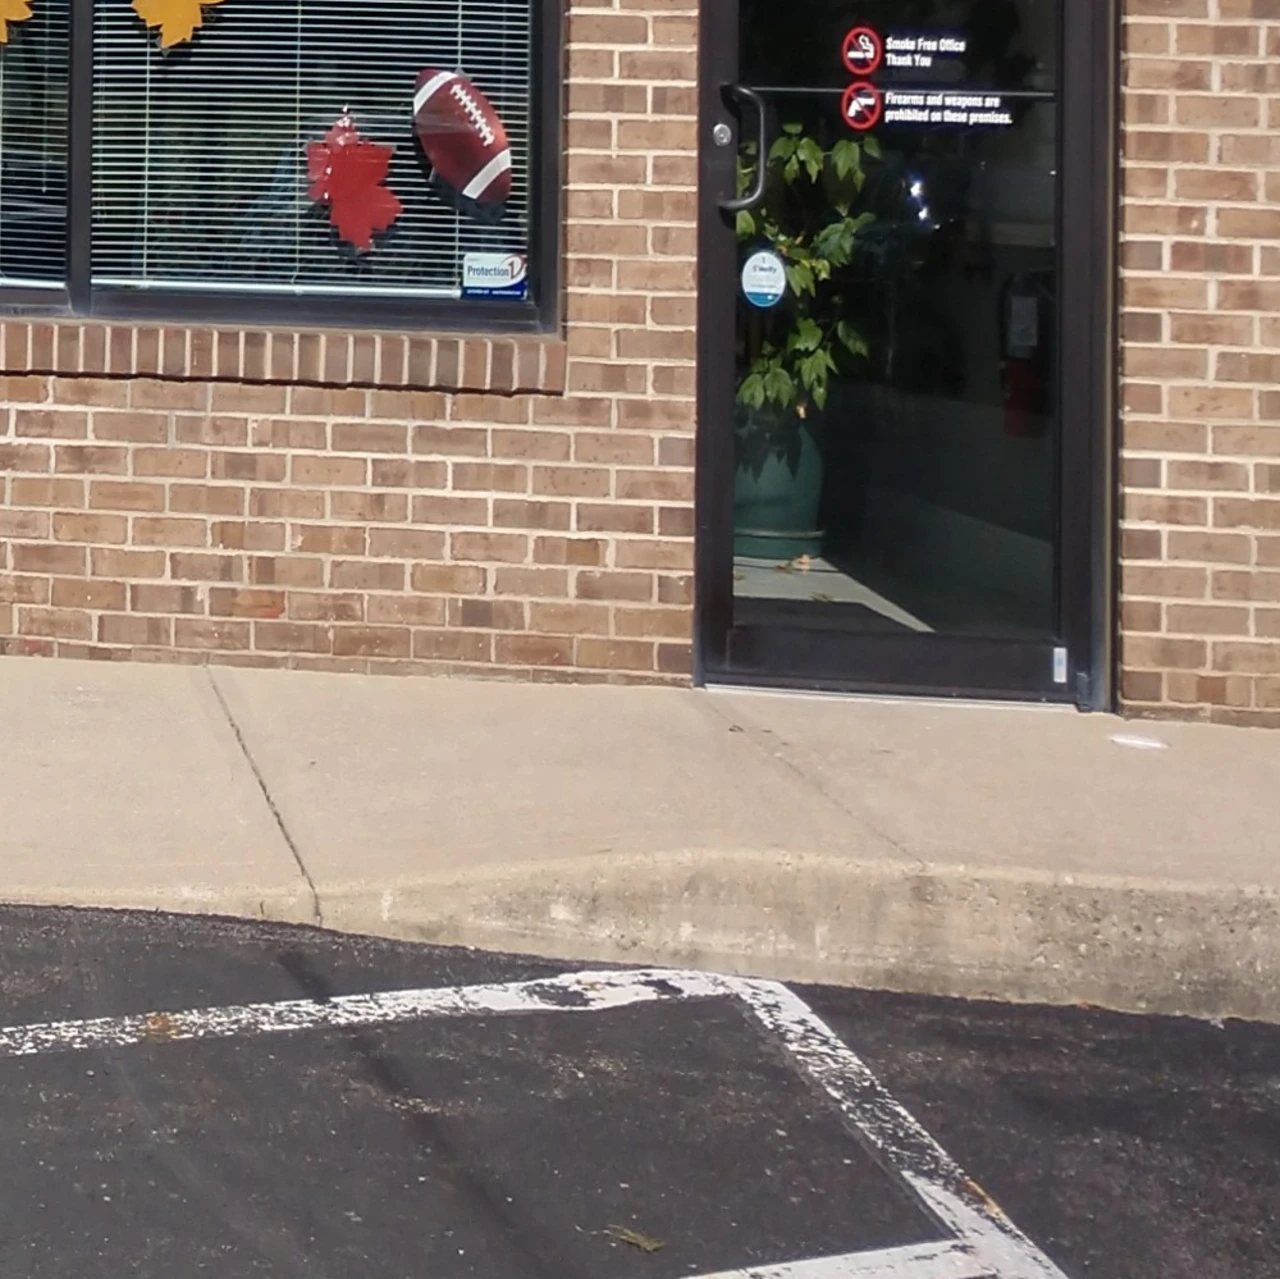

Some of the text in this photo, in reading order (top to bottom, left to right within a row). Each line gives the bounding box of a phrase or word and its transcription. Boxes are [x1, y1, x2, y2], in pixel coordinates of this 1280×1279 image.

[886, 37, 966, 52] Smoke Free Office
[885, 53, 932, 67] Thank You
[885, 92, 1000, 109] Firearms and weapons are
[885, 109, 929, 123] prohibited
[930, 111, 942, 122] on
[943, 110, 968, 122] these
[467, 265, 509, 277] Protection
